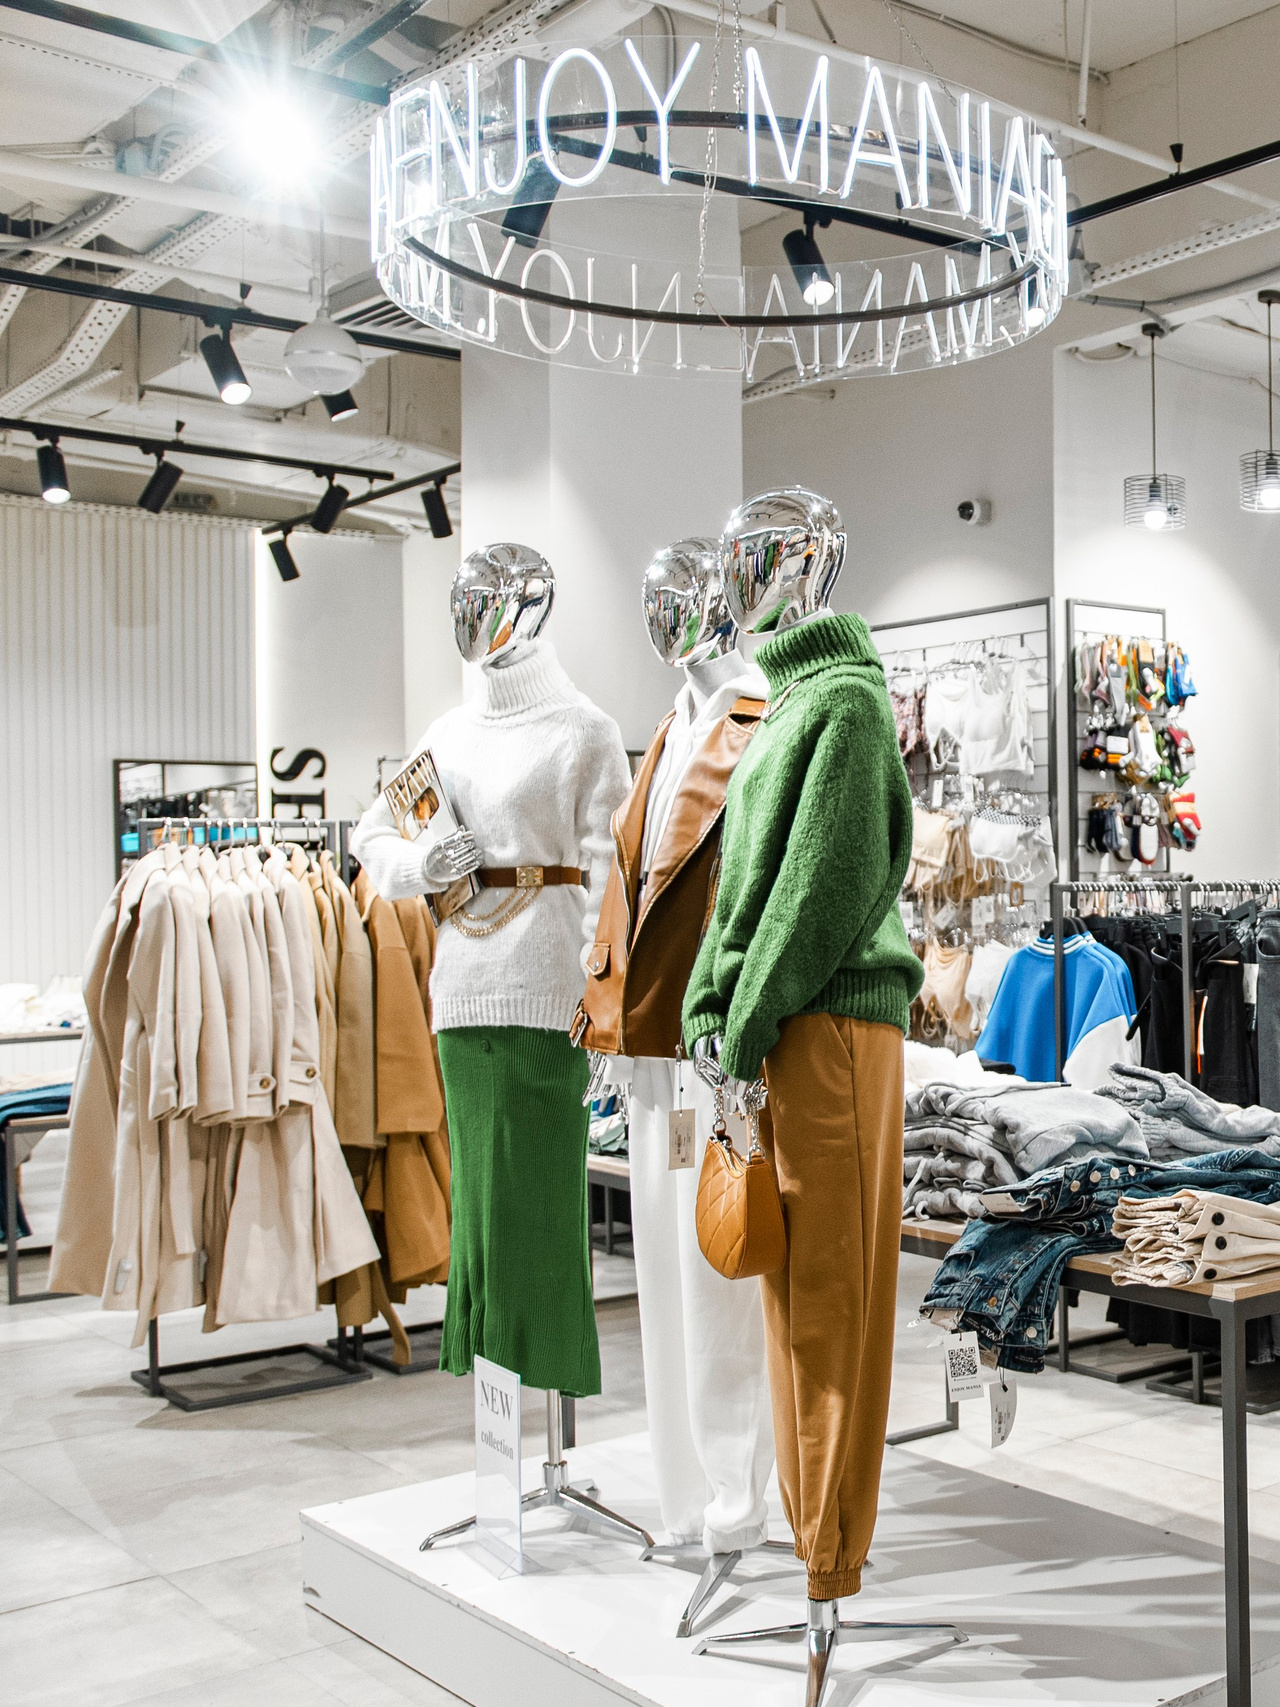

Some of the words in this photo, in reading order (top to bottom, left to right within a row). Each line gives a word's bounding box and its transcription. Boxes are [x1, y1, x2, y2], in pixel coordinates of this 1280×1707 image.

[390, 38, 701, 229] ENJOY
[746, 46, 1043, 250] MANIA
[480, 1379, 514, 1421] NEW
[480, 1430, 514, 1460] collection
